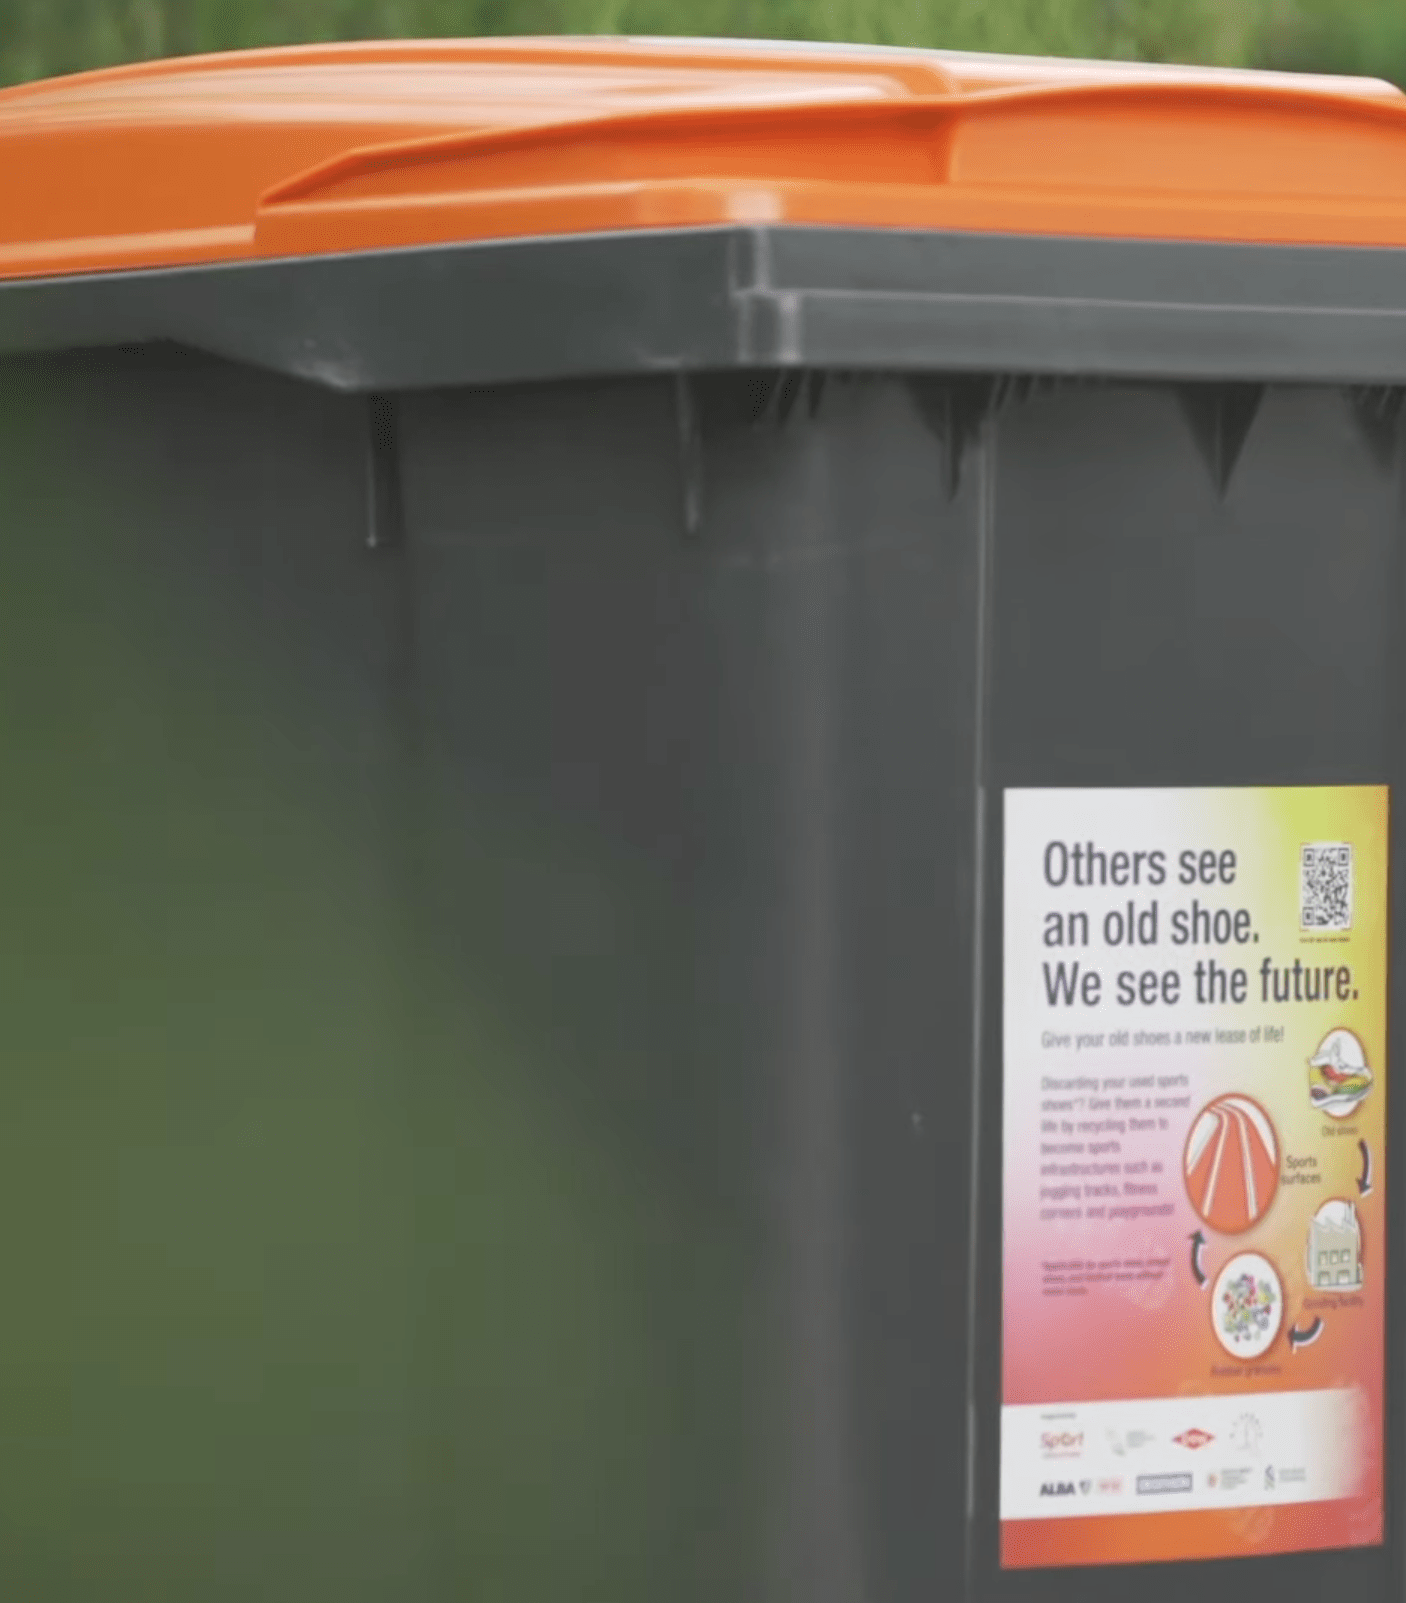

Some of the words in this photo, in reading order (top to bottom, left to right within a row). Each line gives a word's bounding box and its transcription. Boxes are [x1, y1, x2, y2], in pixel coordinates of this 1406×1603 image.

[1044, 841, 1166, 886] Others
[1179, 849, 1236, 885] see
[1043, 911, 1088, 947] an
[1103, 900, 1157, 946] old
[1171, 900, 1259, 944] shoe.
[1042, 961, 1101, 1006] We
[1117, 970, 1180, 1005] see
[1194, 960, 1247, 1004] the
[1260, 957, 1358, 1001] future.
[1041, 1030, 1072, 1048] Give
[1076, 1032, 1105, 1051] your
[1109, 1030, 1129, 1046] old
[1133, 1029, 1171, 1046] shoes
[1174, 1032, 1182, 1045] a
[1185, 1030, 1212, 1044] new
[1215, 1028, 1246, 1044] lease
[1249, 1026, 1261, 1042] of
[1264, 1025, 1285, 1042] life!
[1103, 1078, 1126, 1092] your
[1129, 1074, 1154, 1088] used
[1157, 1073, 1190, 1089] sports
[1286, 1155, 1318, 1169] Sports
[1280, 1172, 1322, 1185] surfaces
